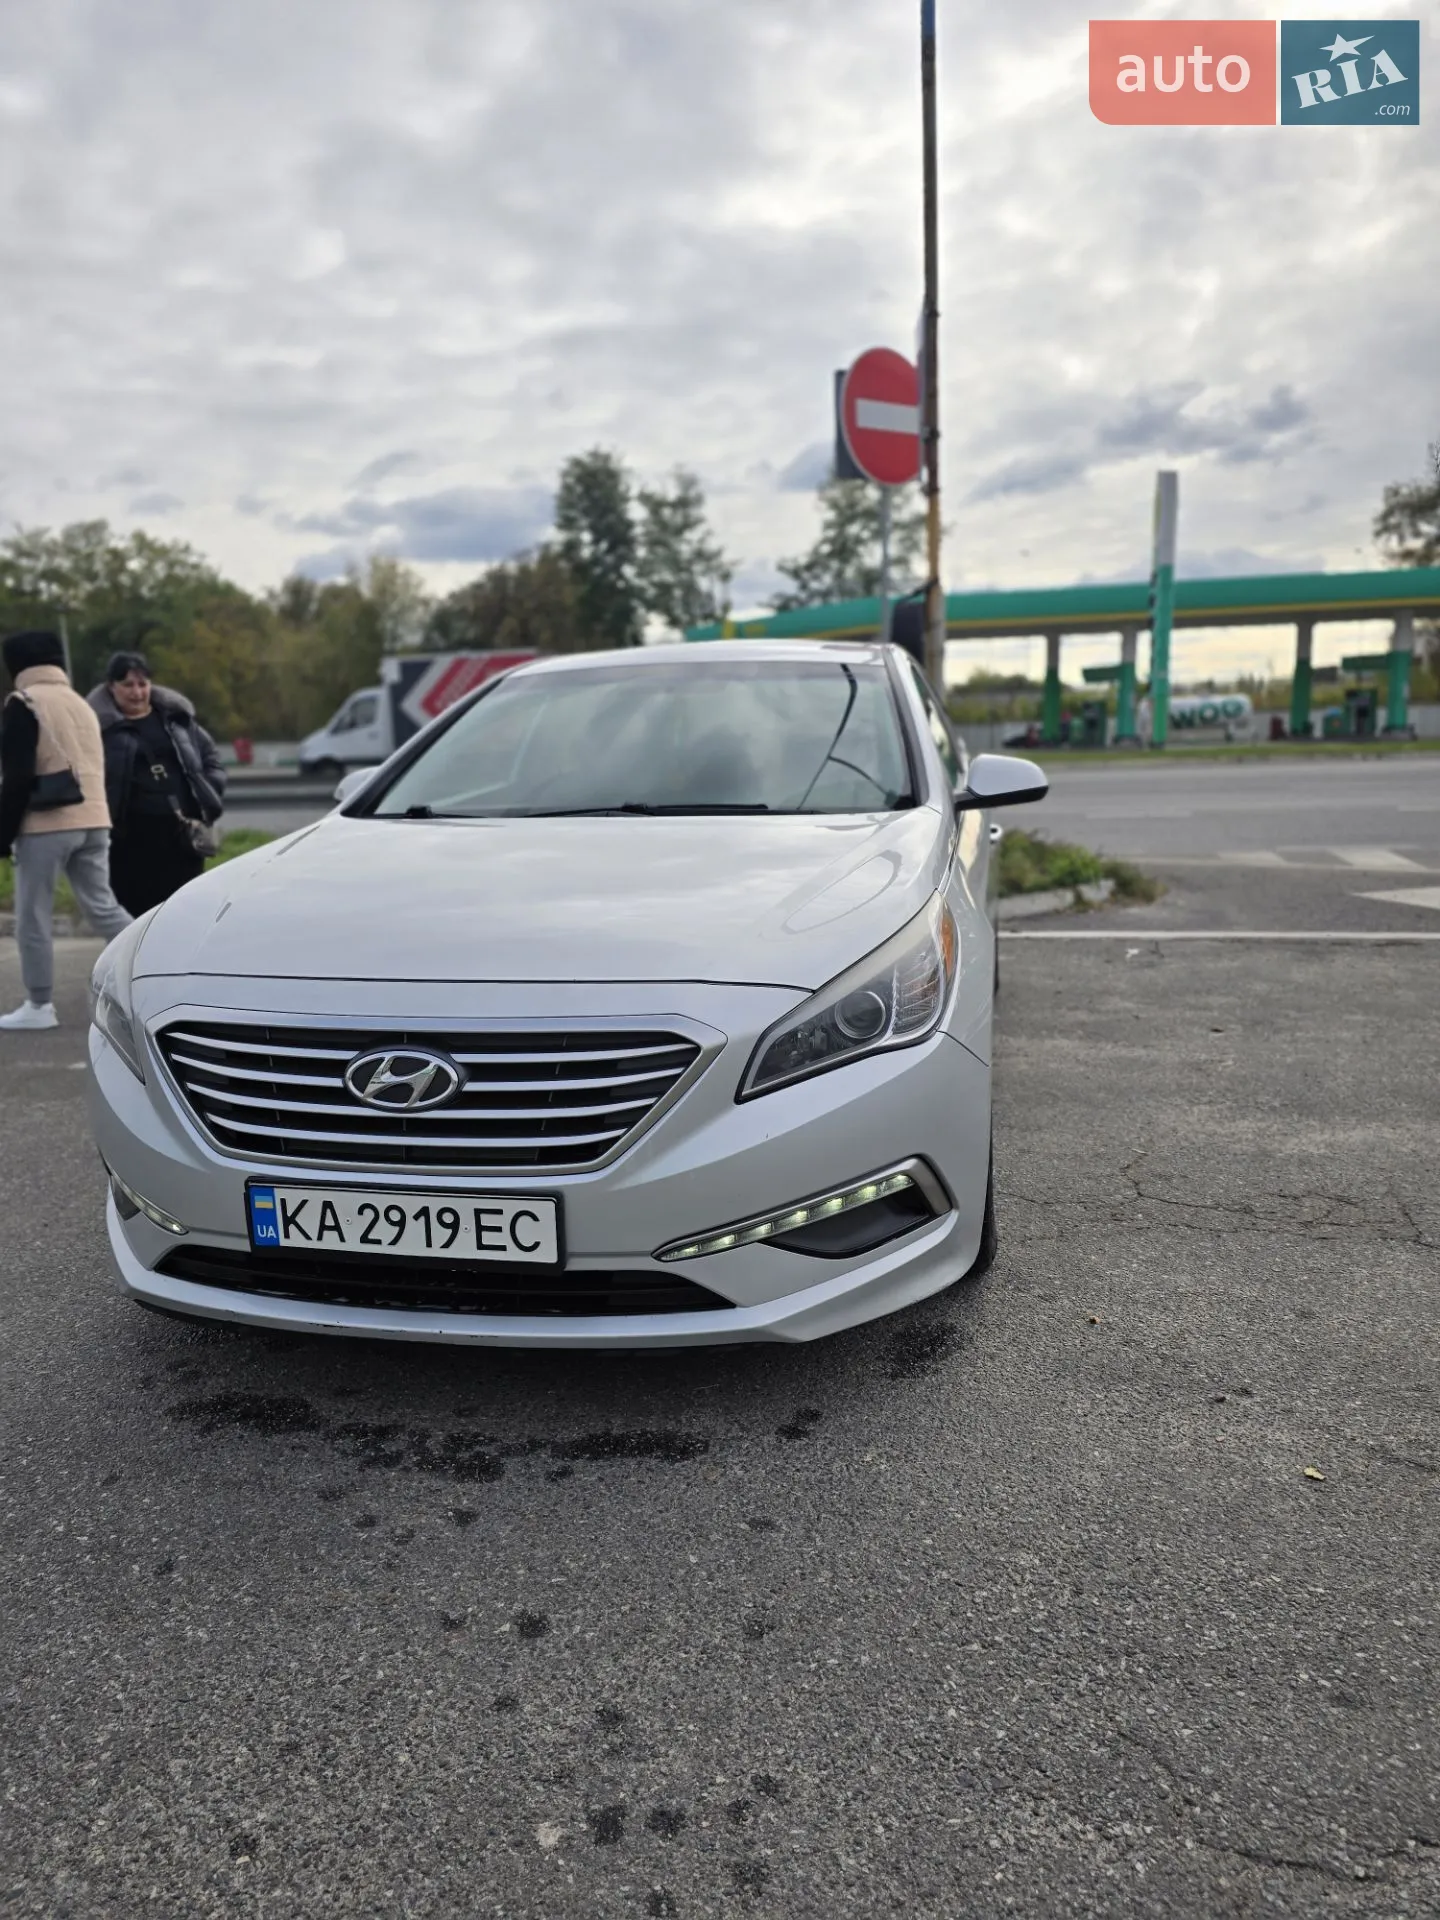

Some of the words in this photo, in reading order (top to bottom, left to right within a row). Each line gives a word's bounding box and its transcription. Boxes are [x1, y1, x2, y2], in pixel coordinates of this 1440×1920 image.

[257, 1224, 277, 1239] UA
[279, 1197, 346, 1243] KA
[357, 1203, 461, 1249] 2919
[473, 1207, 542, 1253] EC
